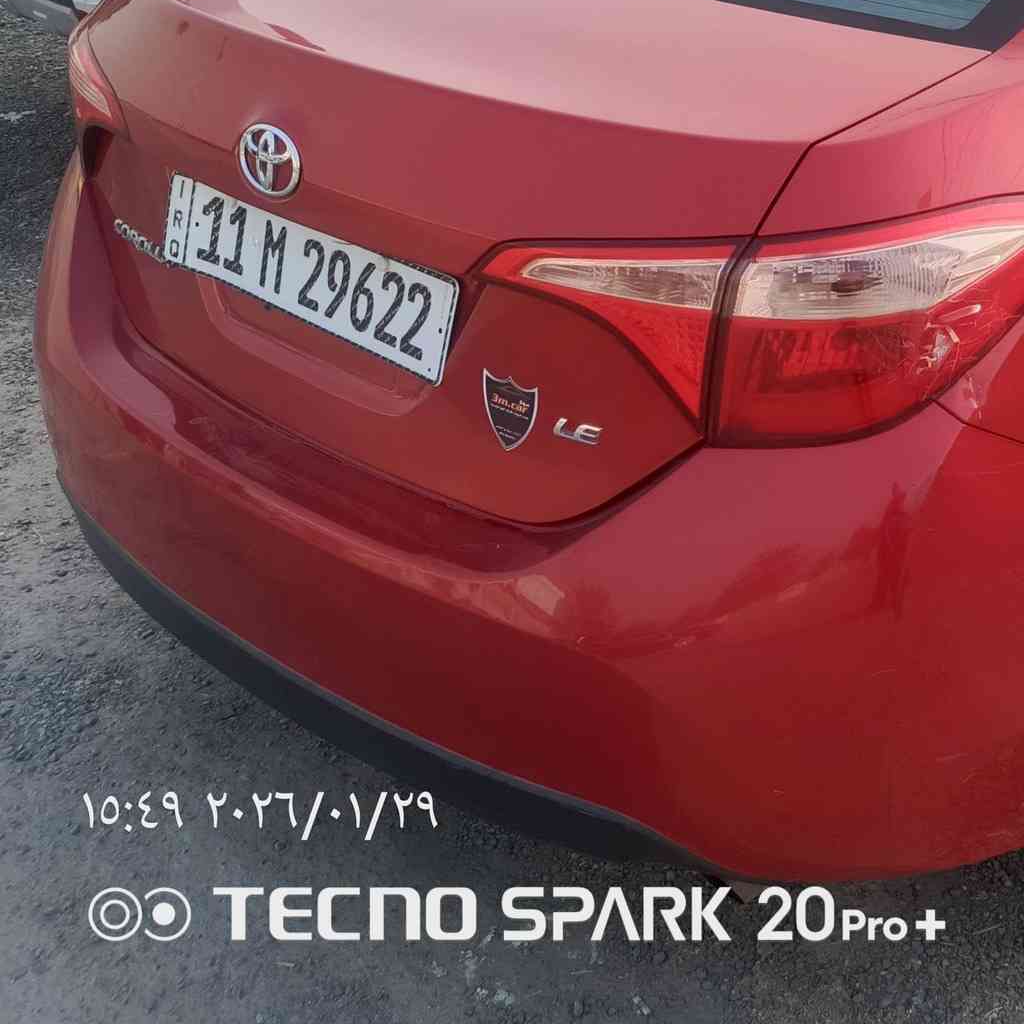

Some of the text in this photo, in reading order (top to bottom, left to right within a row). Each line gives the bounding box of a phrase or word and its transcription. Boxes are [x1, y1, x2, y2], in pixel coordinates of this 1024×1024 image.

[114, 217, 168, 266] COROLL
[195, 195, 434, 362] 11 M 29622
[552, 416, 604, 446] LE
